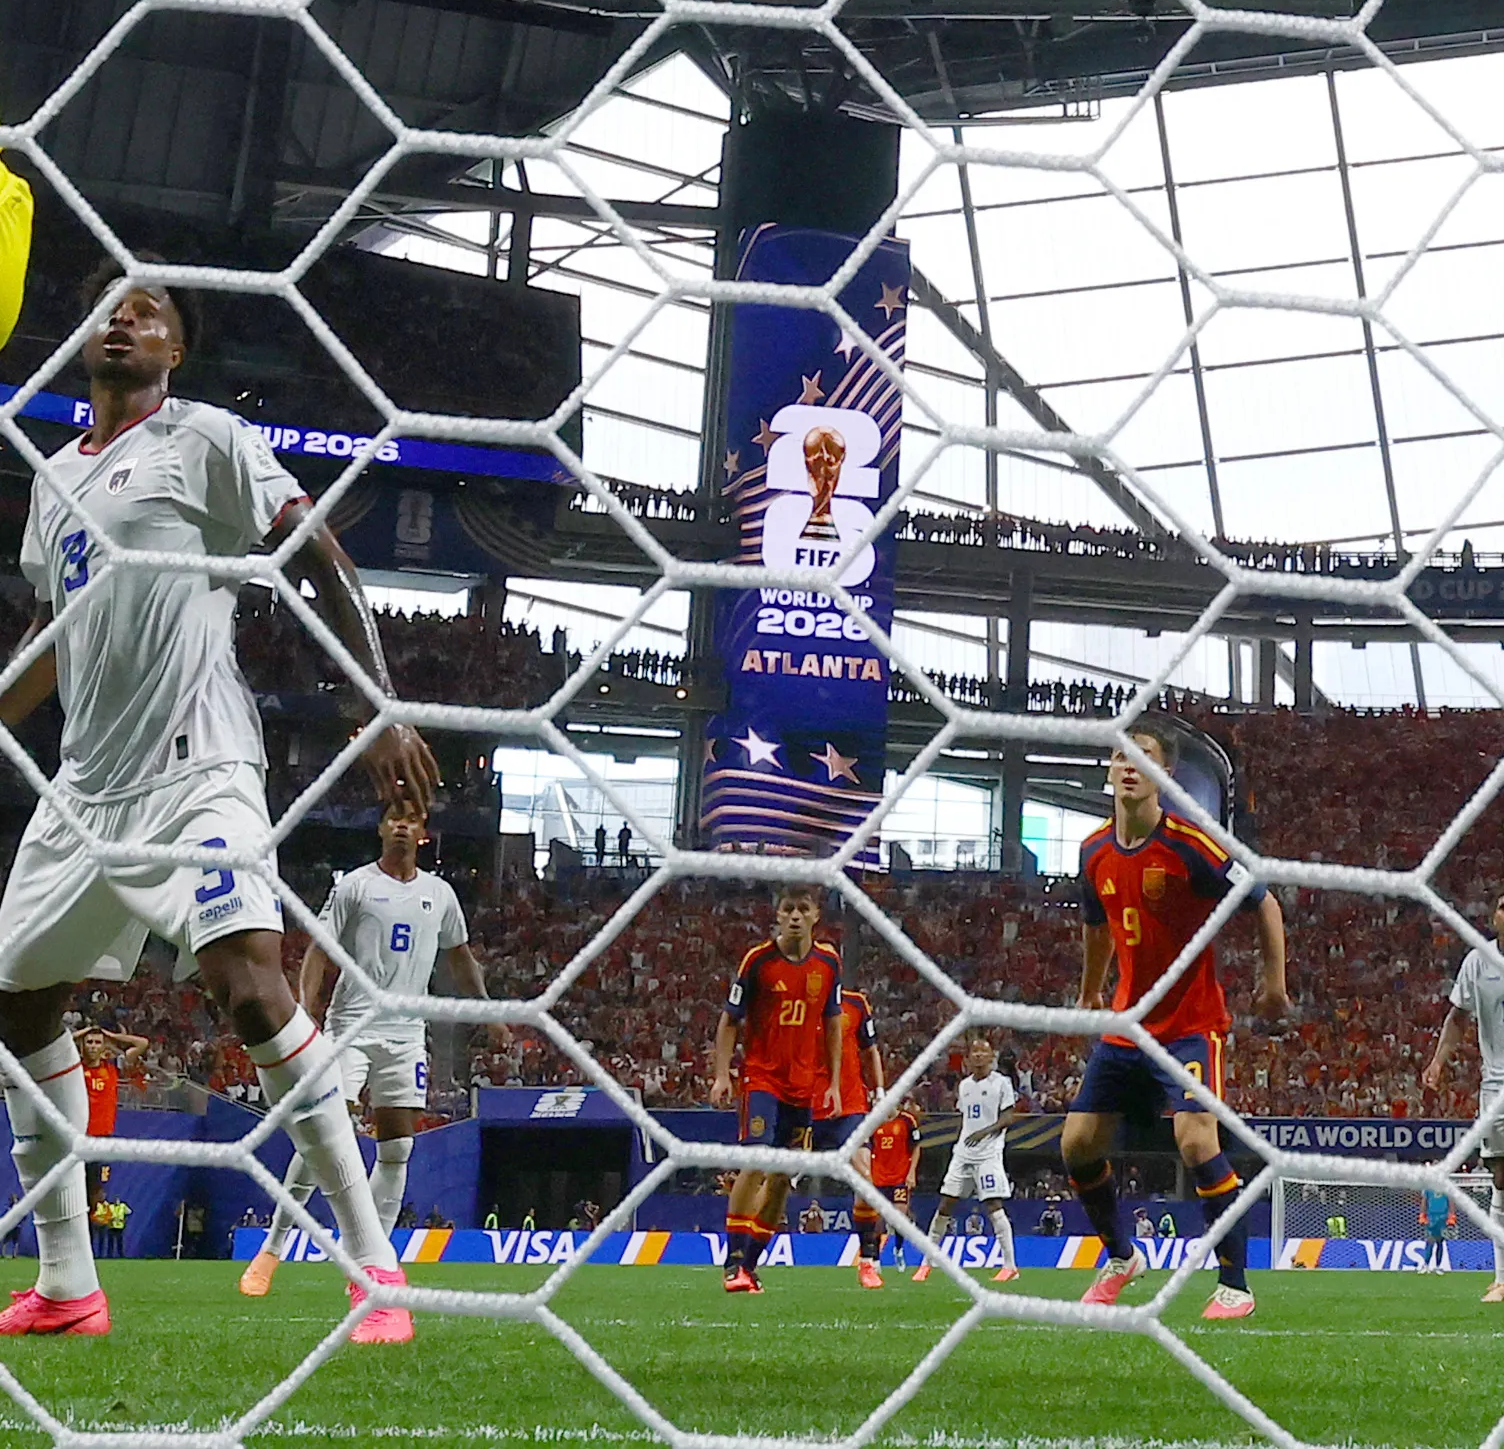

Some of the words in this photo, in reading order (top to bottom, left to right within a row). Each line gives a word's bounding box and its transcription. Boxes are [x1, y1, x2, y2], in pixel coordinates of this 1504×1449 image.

[304, 431, 400, 461] 2026
[759, 588, 831, 609] WORLD
[756, 607, 870, 642] 2026
[741, 649, 882, 682] ATLANTA
[198, 896, 243, 921] capelli
[390, 923, 412, 953] 6
[1122, 907, 1142, 946] 9
[779, 998, 807, 1026] 20
[967, 1104, 981, 1119] 19
[1255, 1124, 1311, 1147] FIFA
[1315, 1125, 1412, 1148] WORLD
[980, 1174, 996, 1190] 19
[482, 1230, 581, 1264] VISA
